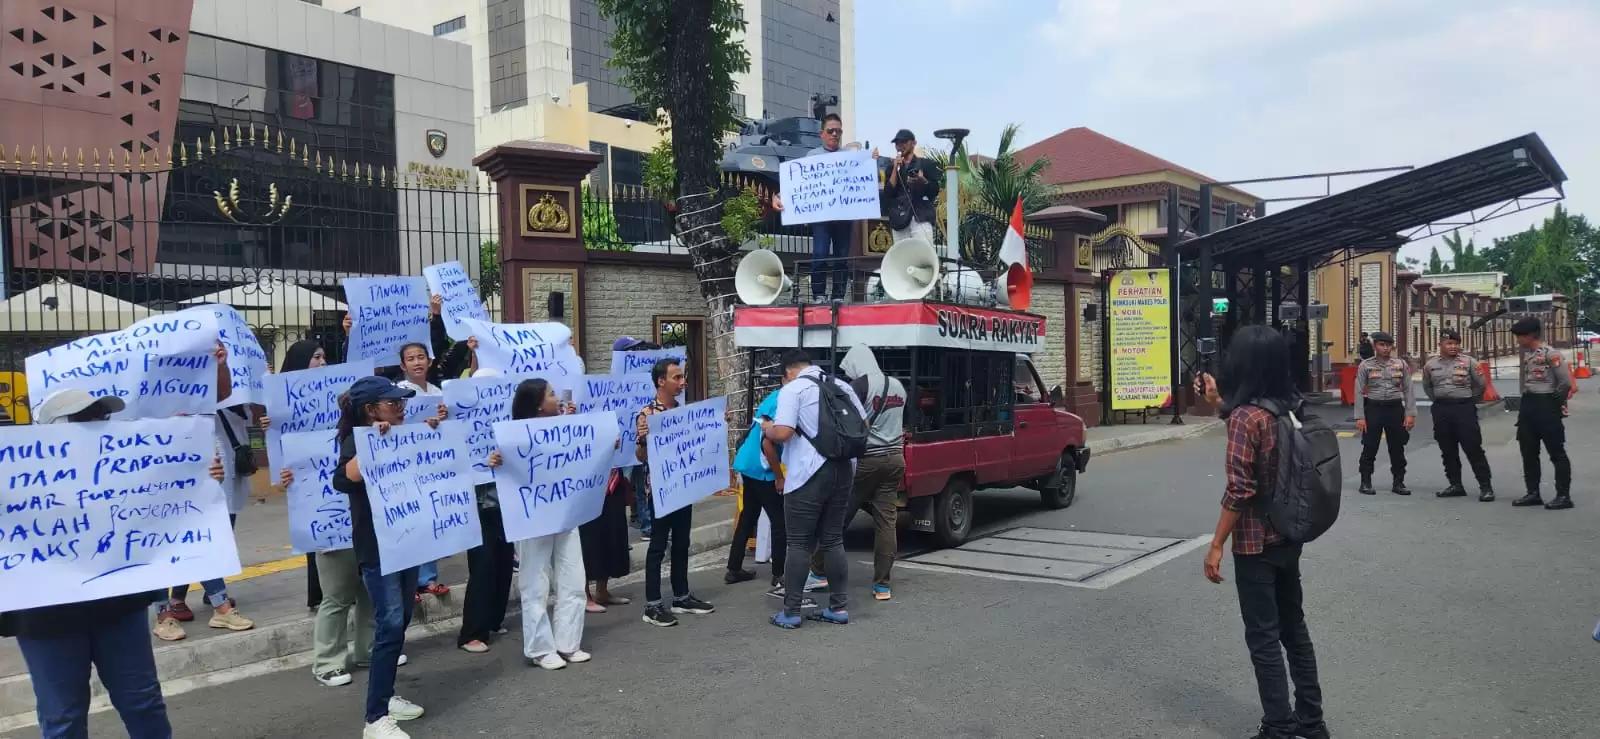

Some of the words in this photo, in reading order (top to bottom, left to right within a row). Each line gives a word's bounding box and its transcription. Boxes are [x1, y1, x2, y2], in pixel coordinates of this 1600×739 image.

[791, 187, 835, 205] FITNAH
[794, 203, 823, 215] AGUM
[1118, 287, 1163, 297] PERHATIAN
[359, 305, 393, 323] AZWAR
[938, 310, 988, 341] SUARA
[991, 315, 1039, 345] RAKYAT
[511, 343, 555, 367] ANTI
[1122, 347, 1146, 355] MOTOR
[43, 358, 129, 388] KORBAN
[143, 352, 209, 373] FITNAH
[623, 354, 657, 375] PRABOW
[151, 378, 209, 399] AGUM
[586, 379, 651, 398] WIRANTO
[293, 398, 320, 420] AKSI
[100, 433, 173, 454] BUKU
[517, 423, 594, 458] Jangan
[10, 468, 77, 489] ITAM
[93, 452, 202, 486] PRABOWO
[528, 443, 592, 485] FITNAH
[682, 463, 717, 489] FITNAH
[384, 499, 421, 527] ADALAH
[429, 490, 470, 518] FITNAH
[519, 474, 605, 519] PRABOWO
[432, 511, 469, 539] HOAKS
[126, 527, 212, 561] FITNAH
